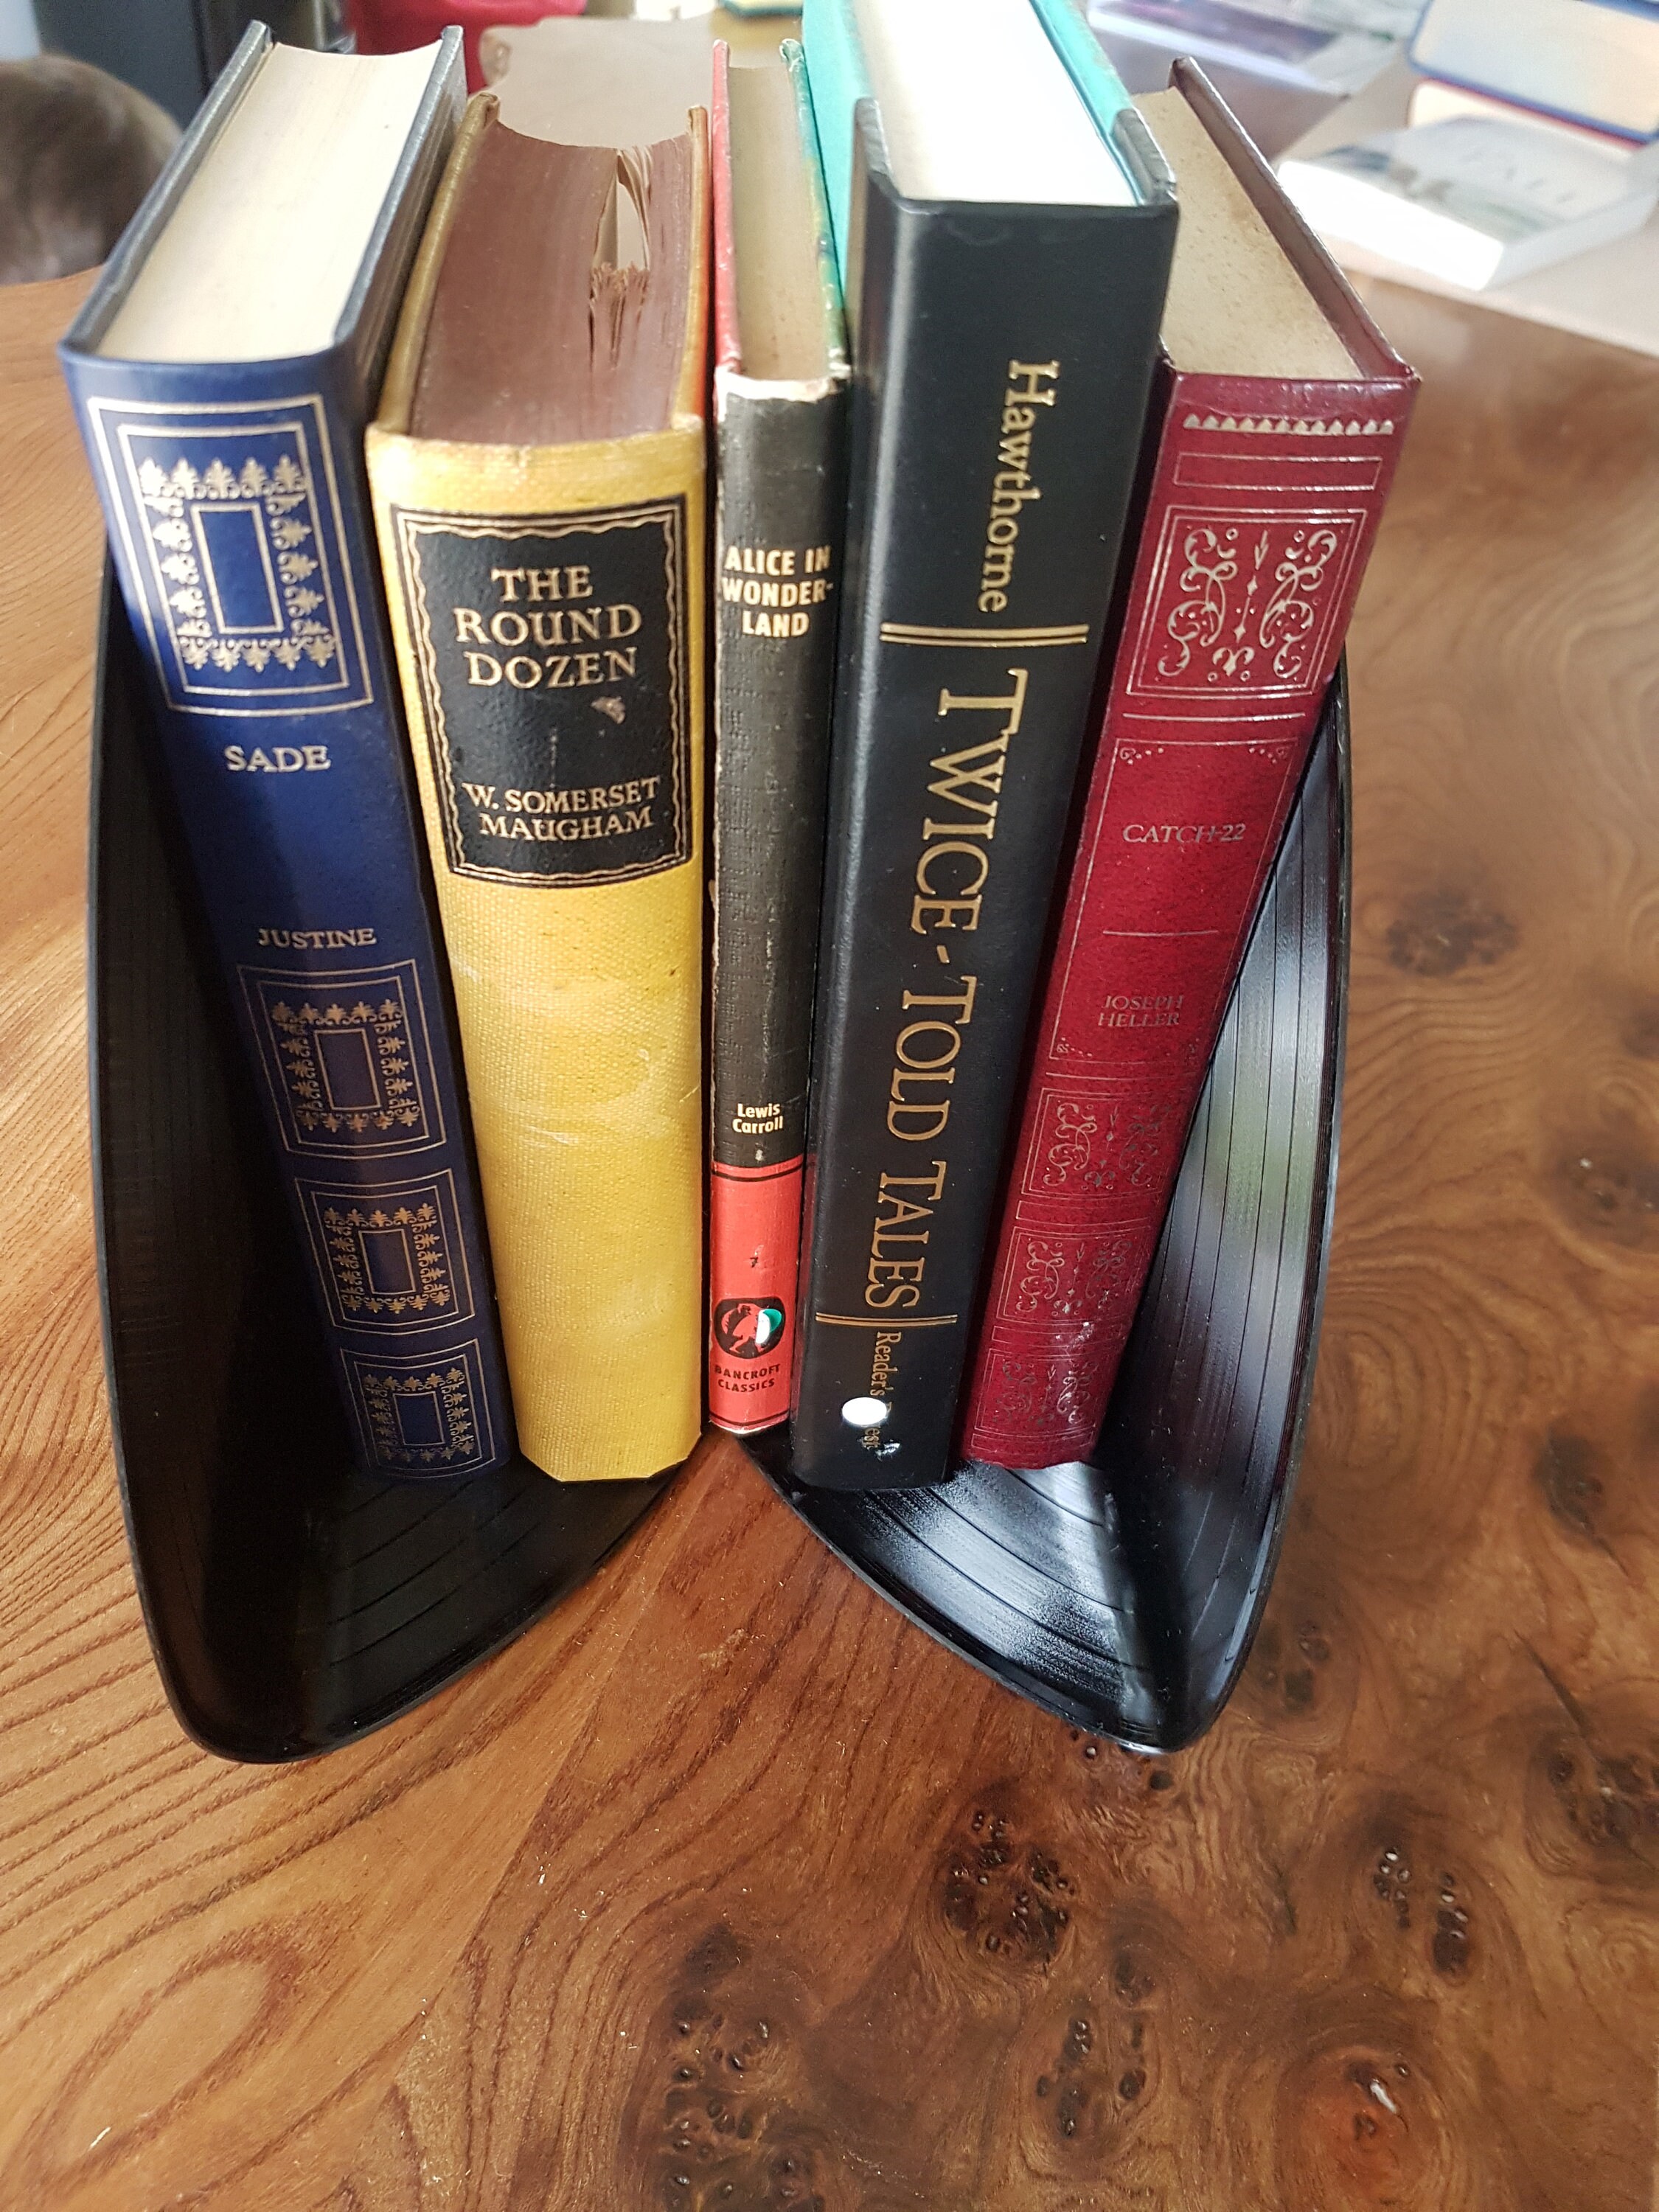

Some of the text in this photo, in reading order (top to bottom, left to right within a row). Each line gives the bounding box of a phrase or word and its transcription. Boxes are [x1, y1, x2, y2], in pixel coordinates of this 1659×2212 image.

[978, 359, 1060, 613] Hawthorne
[724, 544, 831, 576] ALICE IN
[490, 565, 593, 602] THE
[722, 577, 834, 608] WONDER-
[452, 604, 641, 647] ROUND
[742, 610, 810, 637] LAND
[463, 646, 638, 689] DOZEN
[224, 745, 331, 772] SADE
[462, 776, 661, 814] W. SOMERSET
[479, 805, 655, 841] MAUGHAM
[1122, 823, 1246, 844] CATCH-22
[258, 928, 377, 950] JUSTINE
[1102, 995, 1183, 1011] JOSEPH
[1098, 1012, 1180, 1027] HELLER
[732, 1116, 783, 1134] Carroll
[737, 1103, 780, 1119] Lewis
[864, 1160, 947, 1308] TALES
[714, 1364, 780, 1380] BANCROFT
[718, 1378, 775, 1393] CLASSICS
[861, 1332, 902, 1451] Reader's est
